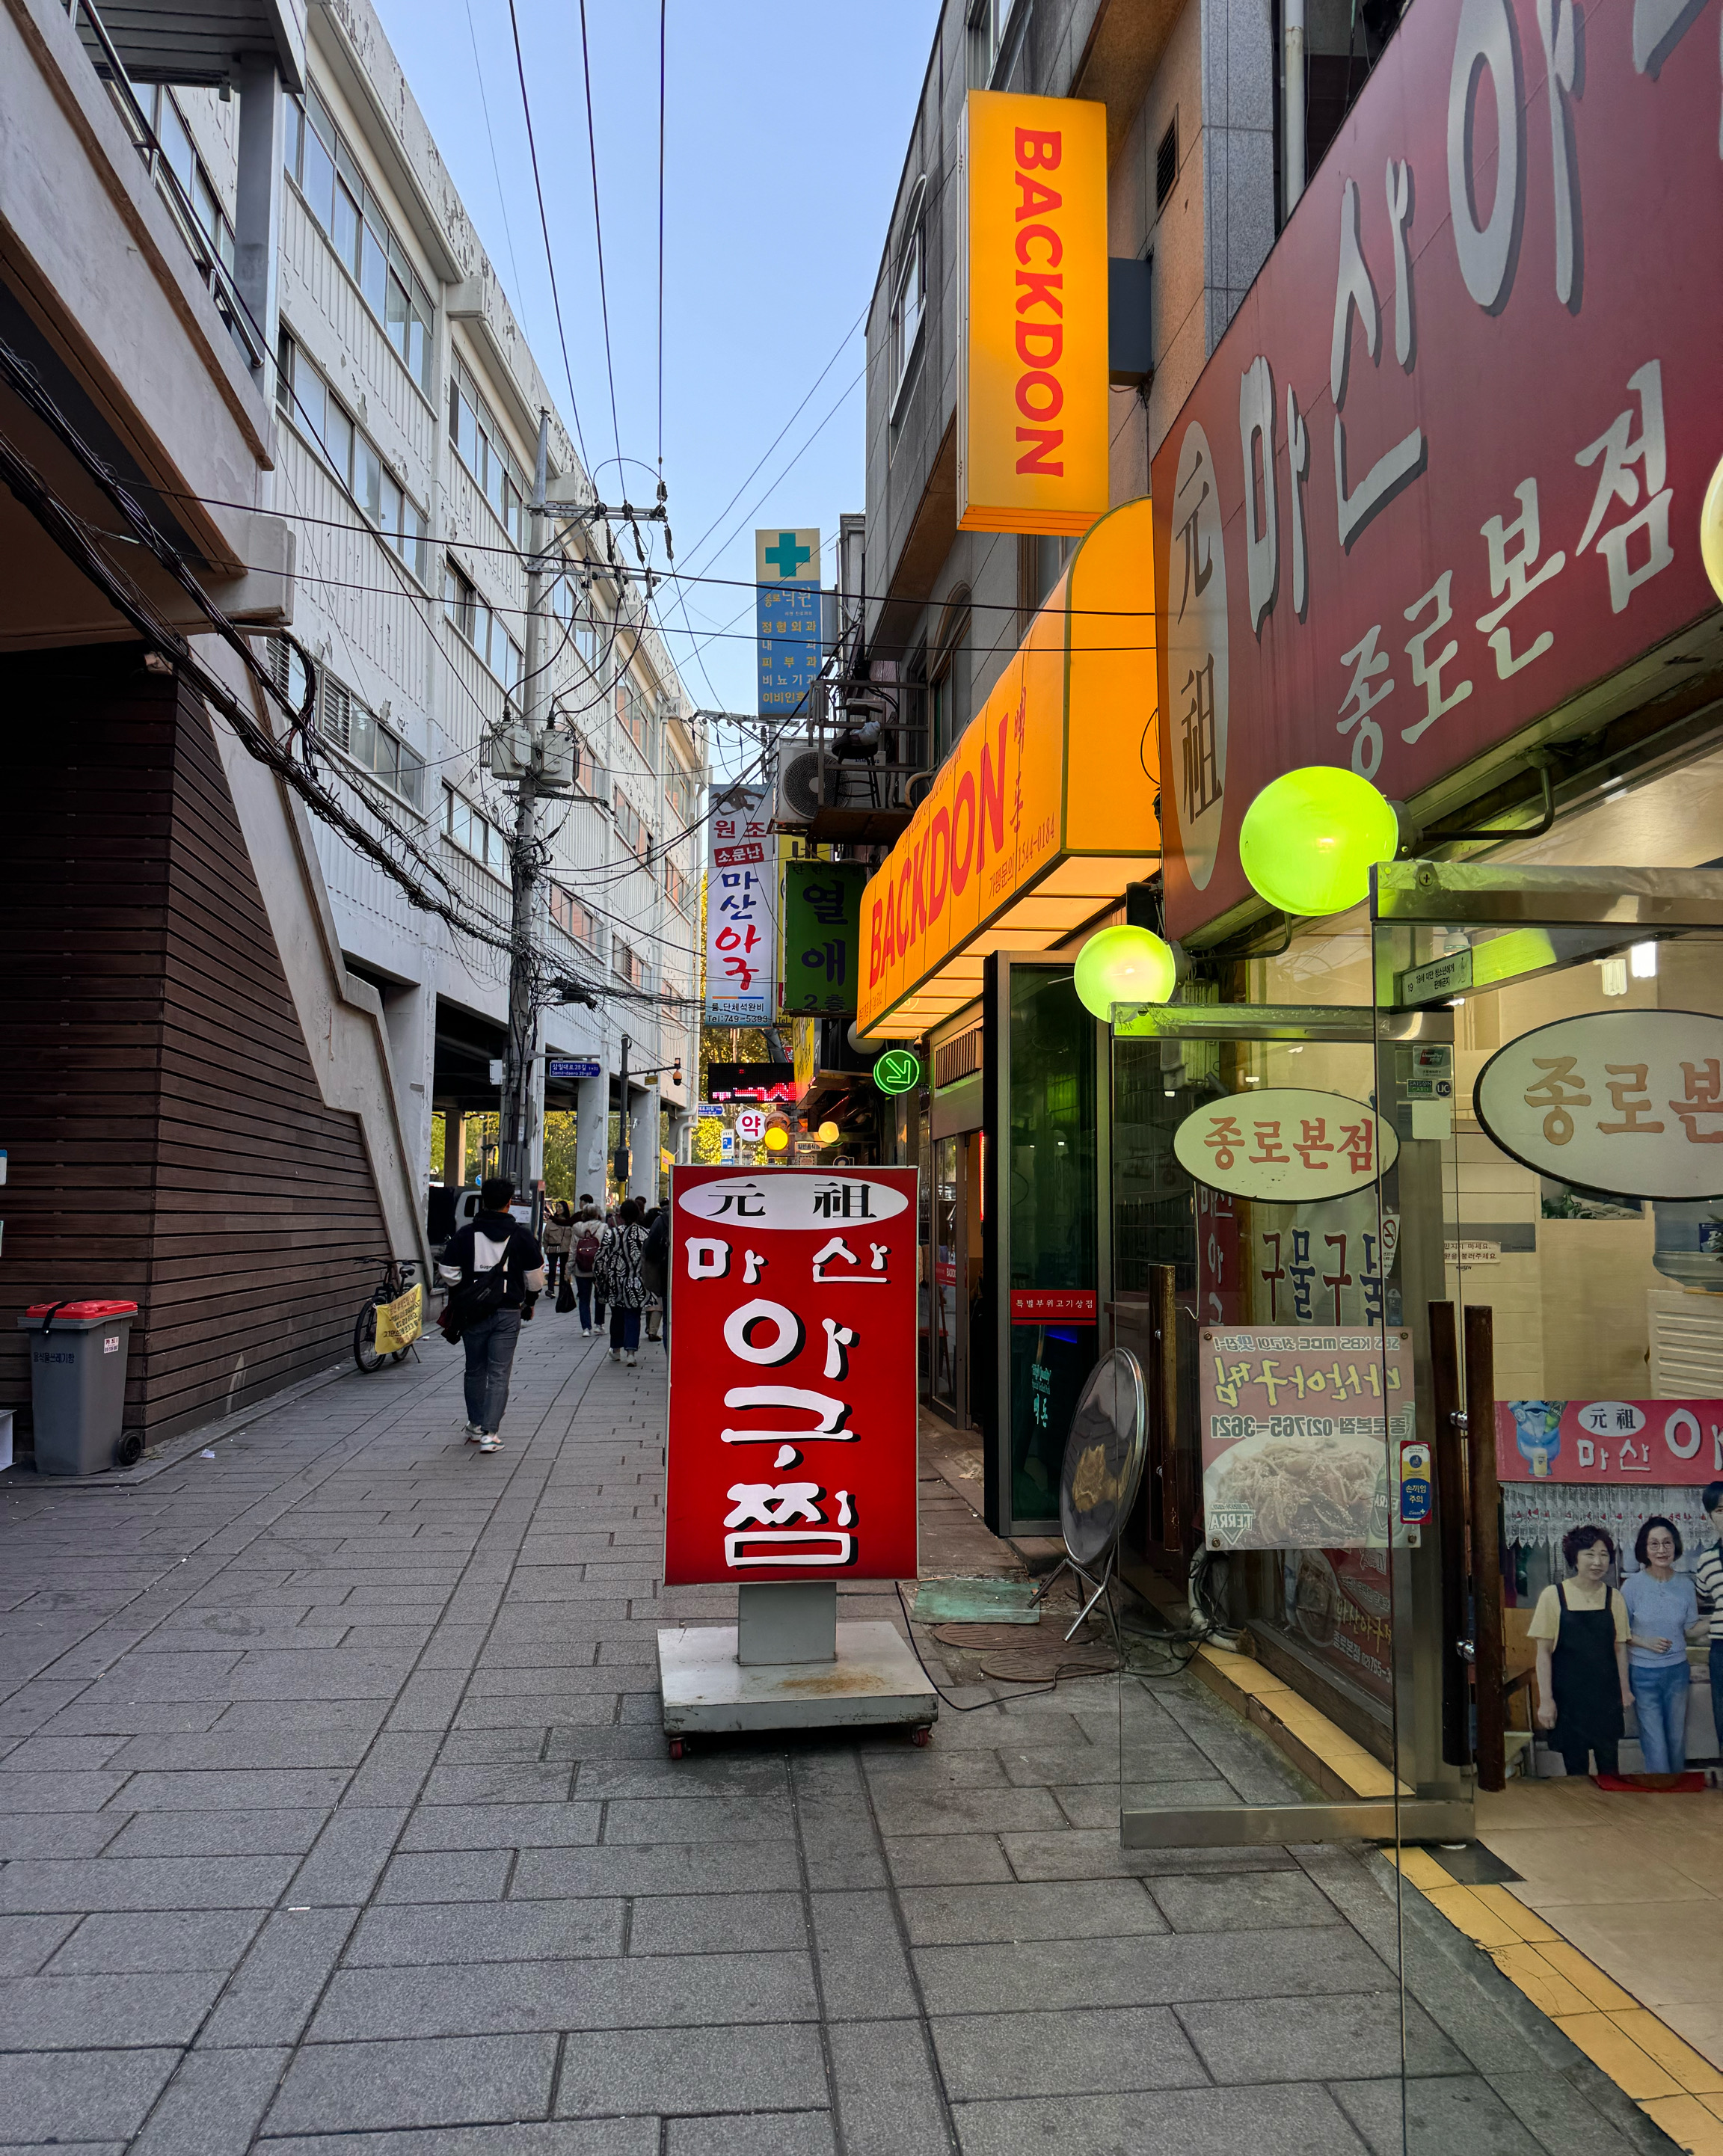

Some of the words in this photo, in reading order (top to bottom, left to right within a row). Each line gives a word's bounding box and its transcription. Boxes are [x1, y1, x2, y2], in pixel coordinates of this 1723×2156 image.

[1015, 126, 1064, 478] BACKDON
[1336, 358, 1674, 782] 종로본점
[761, 621, 817, 633] 정형외과
[1175, 449, 1223, 825] 元祖
[713, 820, 767, 839] 원조
[1017, 811, 1055, 873] 1544-0184
[717, 847, 761, 862] 소문난
[869, 713, 1009, 989] BACKDON
[802, 879, 849, 986] 열애
[742, 1116, 761, 1137] 약
[1203, 1117, 1374, 1174] 종로본점
[707, 1183, 877, 1218] 元祖
[685, 1236, 891, 1284] 마산
[34, 1352, 75, 1364] 음식물쓰레기함
[1590, 1408, 1636, 1430] 元祖
[1576, 1438, 1650, 1472] 마산
[1406, 1484, 1426, 1493] 손끼임
[1410, 1496, 1423, 1504] 주의
